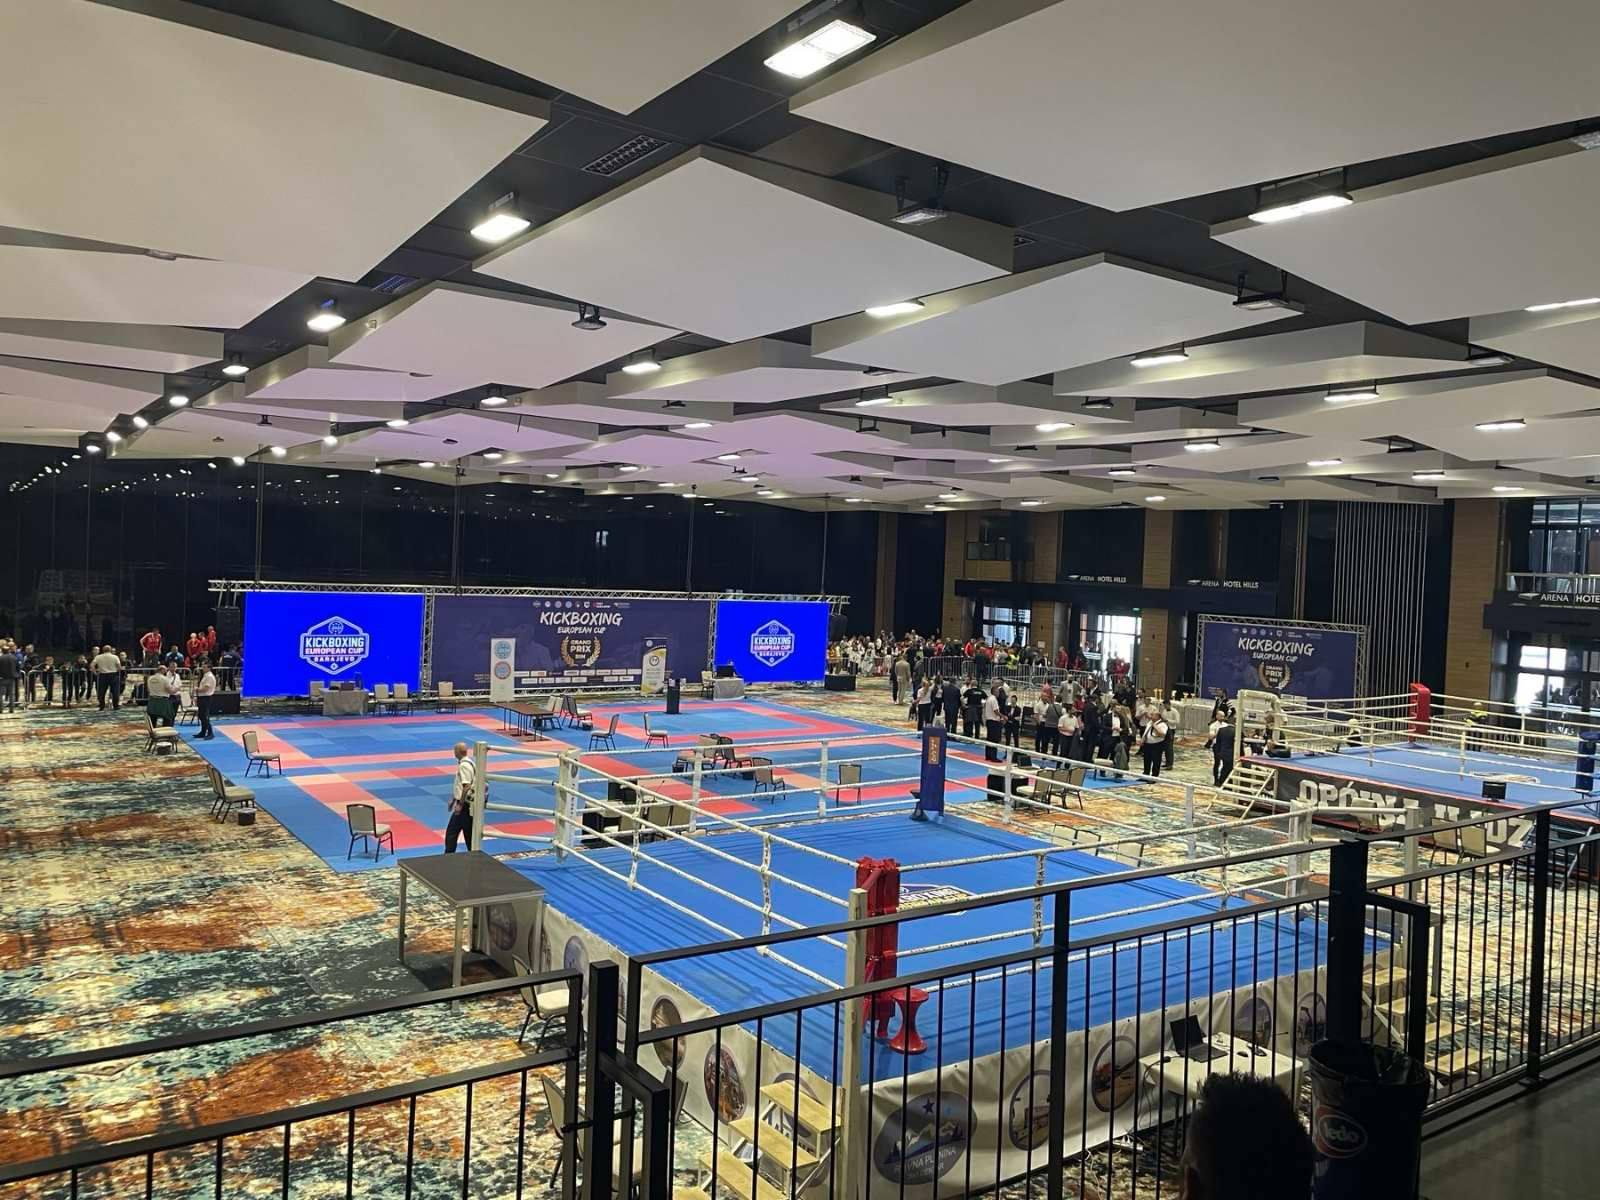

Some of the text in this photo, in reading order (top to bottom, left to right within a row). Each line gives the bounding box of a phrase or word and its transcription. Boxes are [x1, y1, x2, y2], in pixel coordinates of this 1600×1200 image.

[1540, 593, 1569, 602] ARENA
[540, 611, 623, 626] KICKBOXING
[557, 626, 607, 634] EUROPEAN CUP
[305, 637, 365, 648] KICKBOXING
[754, 636, 792, 645] KICKBOXING
[305, 647, 347, 655] EUROPEAN
[570, 645, 592, 653] PRIX
[1238, 637, 1315, 656] KICKBOXING
[1252, 652, 1284, 661] EUROPEAN
